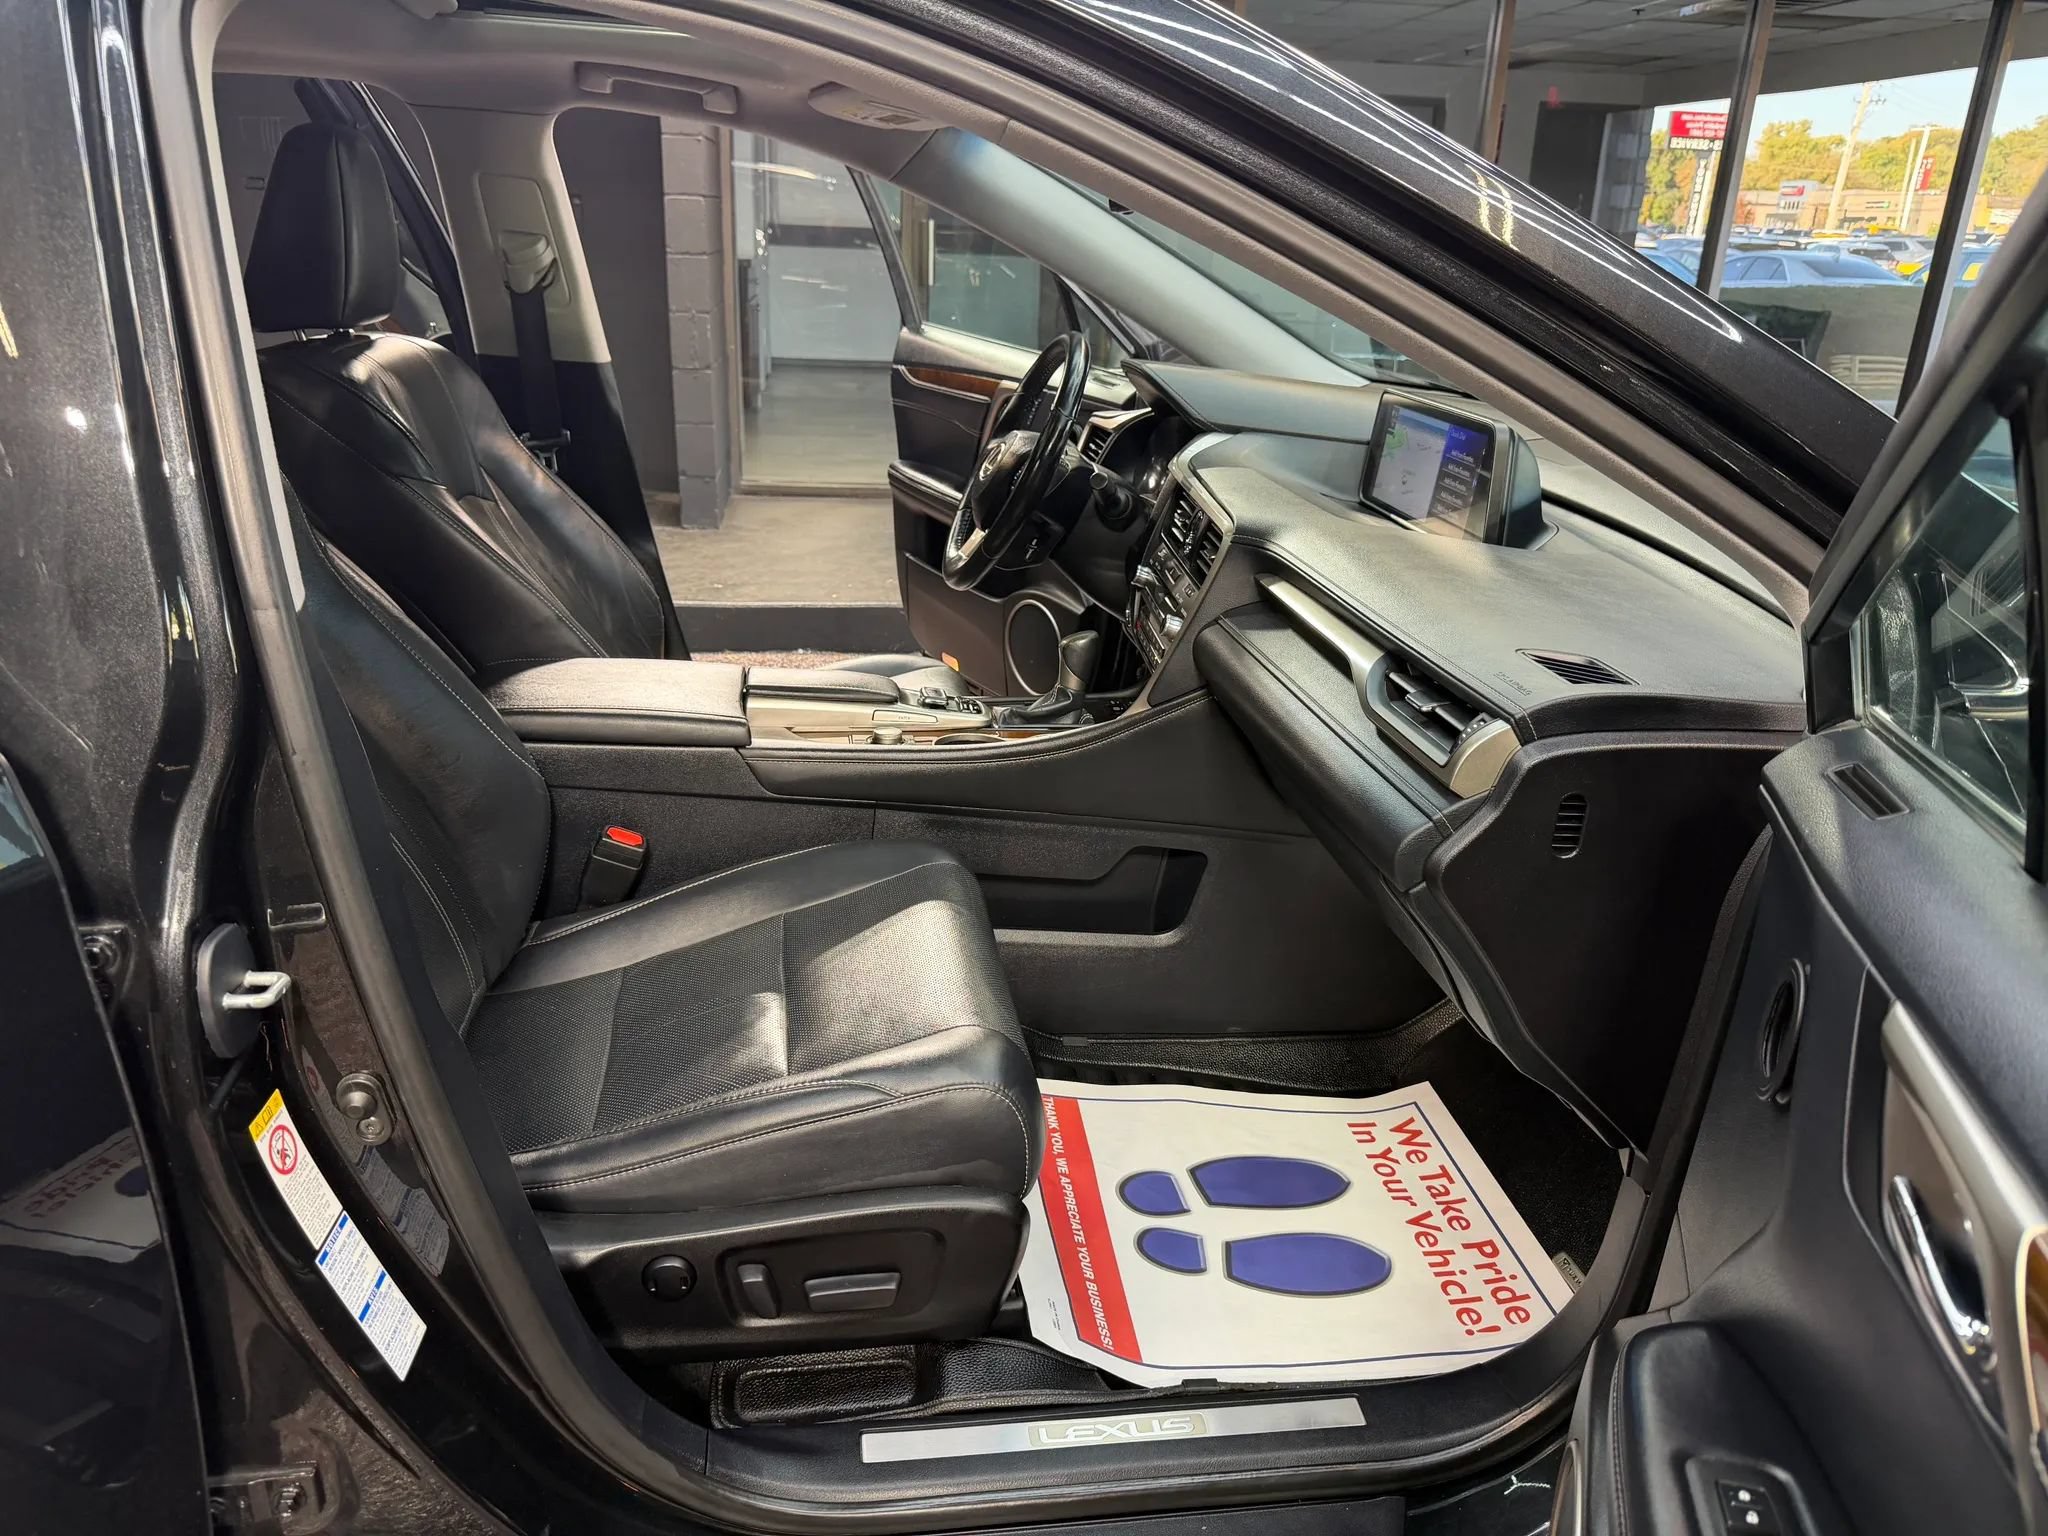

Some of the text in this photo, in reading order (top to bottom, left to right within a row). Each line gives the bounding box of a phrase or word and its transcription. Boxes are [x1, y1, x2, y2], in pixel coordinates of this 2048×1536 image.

[1042, 1096, 1114, 1351] THANK YOU, WE APPRECIATE YOUR BUSINESS!
[1346, 1122, 1502, 1337] In Your Vehicle!
[1388, 1116, 1532, 1325] We Take Pride
[1038, 1416, 1196, 1444] LEXUS
